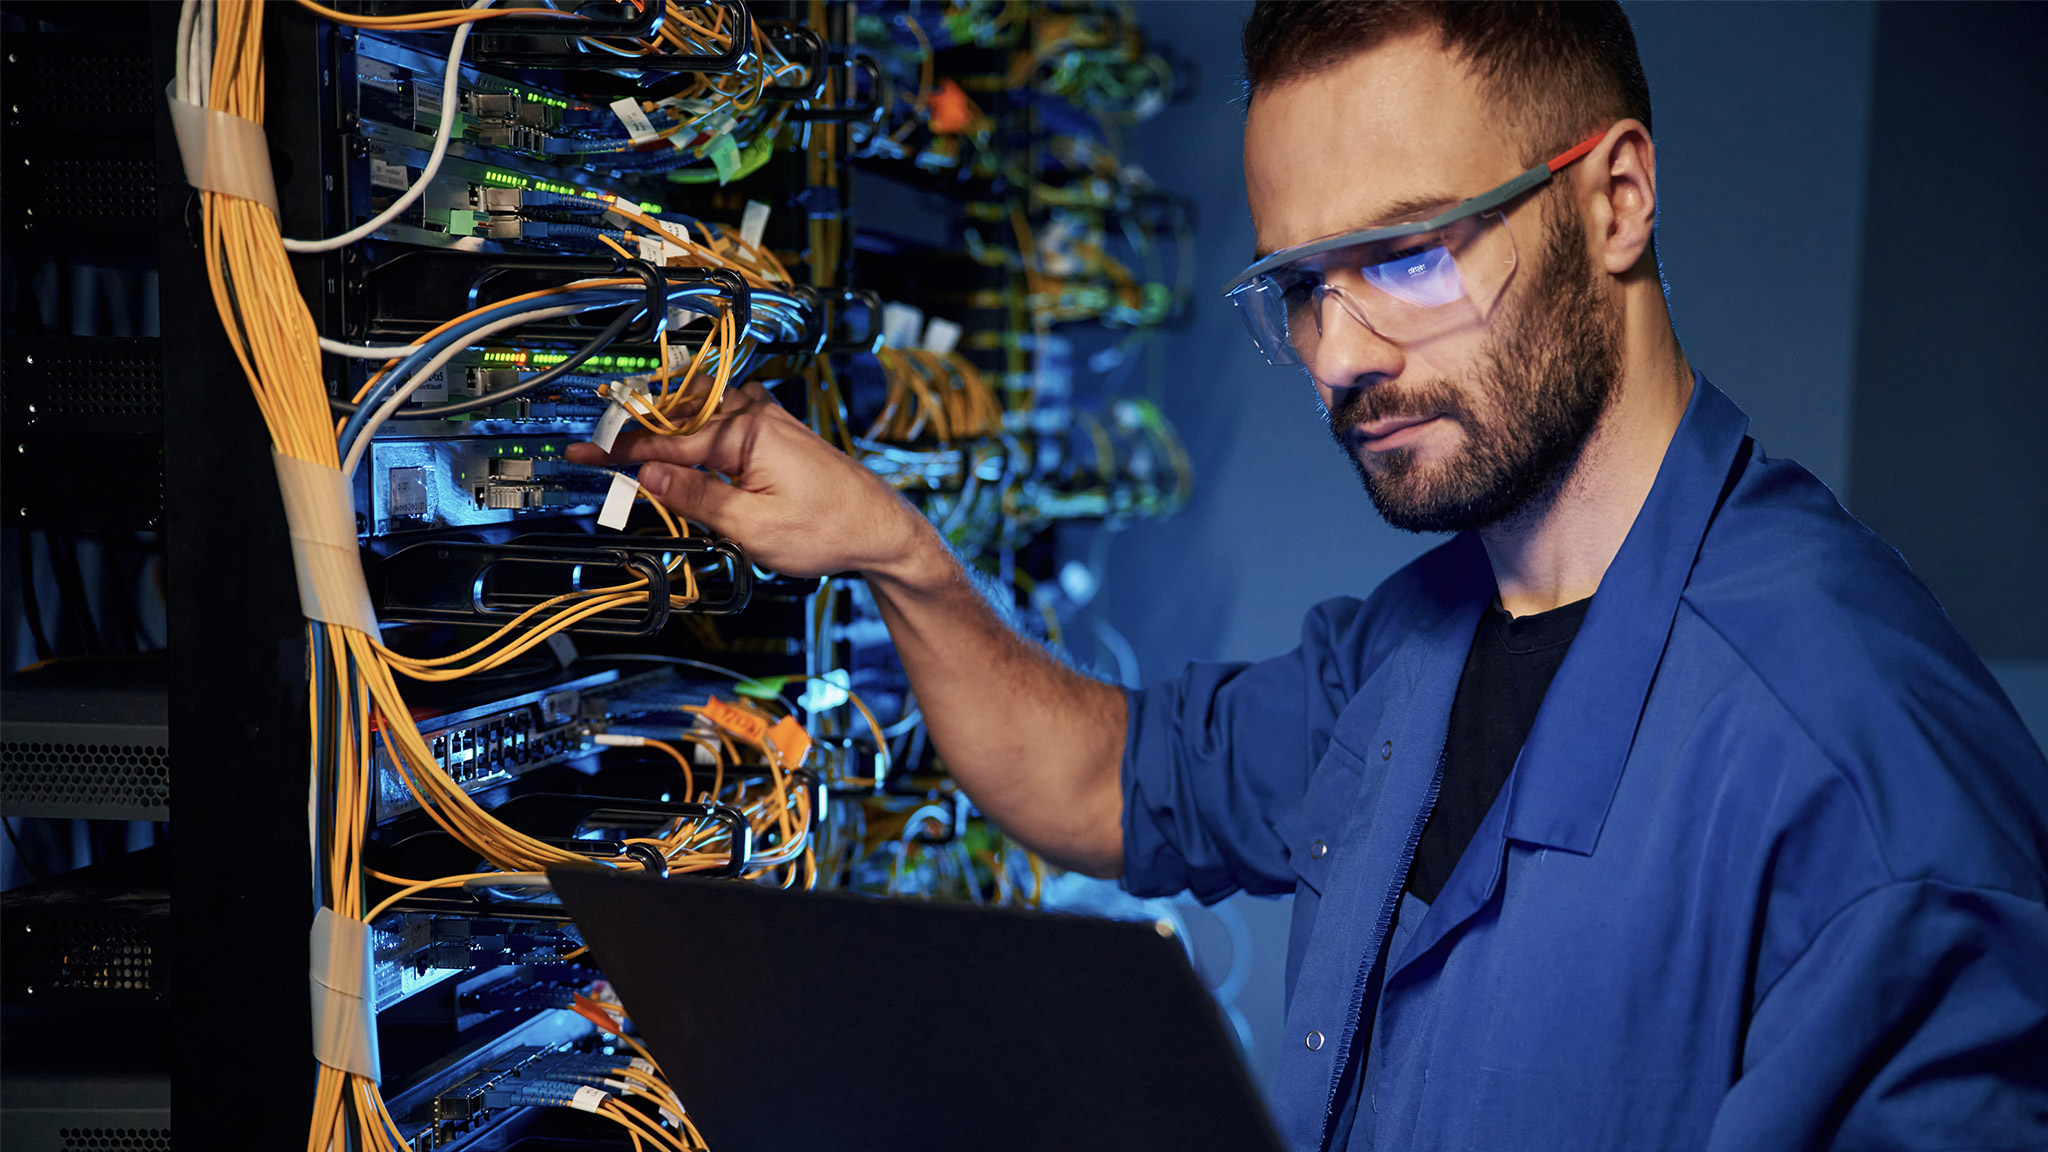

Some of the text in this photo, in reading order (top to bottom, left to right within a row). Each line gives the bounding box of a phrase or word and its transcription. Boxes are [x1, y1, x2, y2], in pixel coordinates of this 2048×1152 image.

[324, 69, 329, 86] 9
[325, 174, 334, 191] 10
[328, 278, 335, 294] 11
[330, 380, 338, 395] 12
